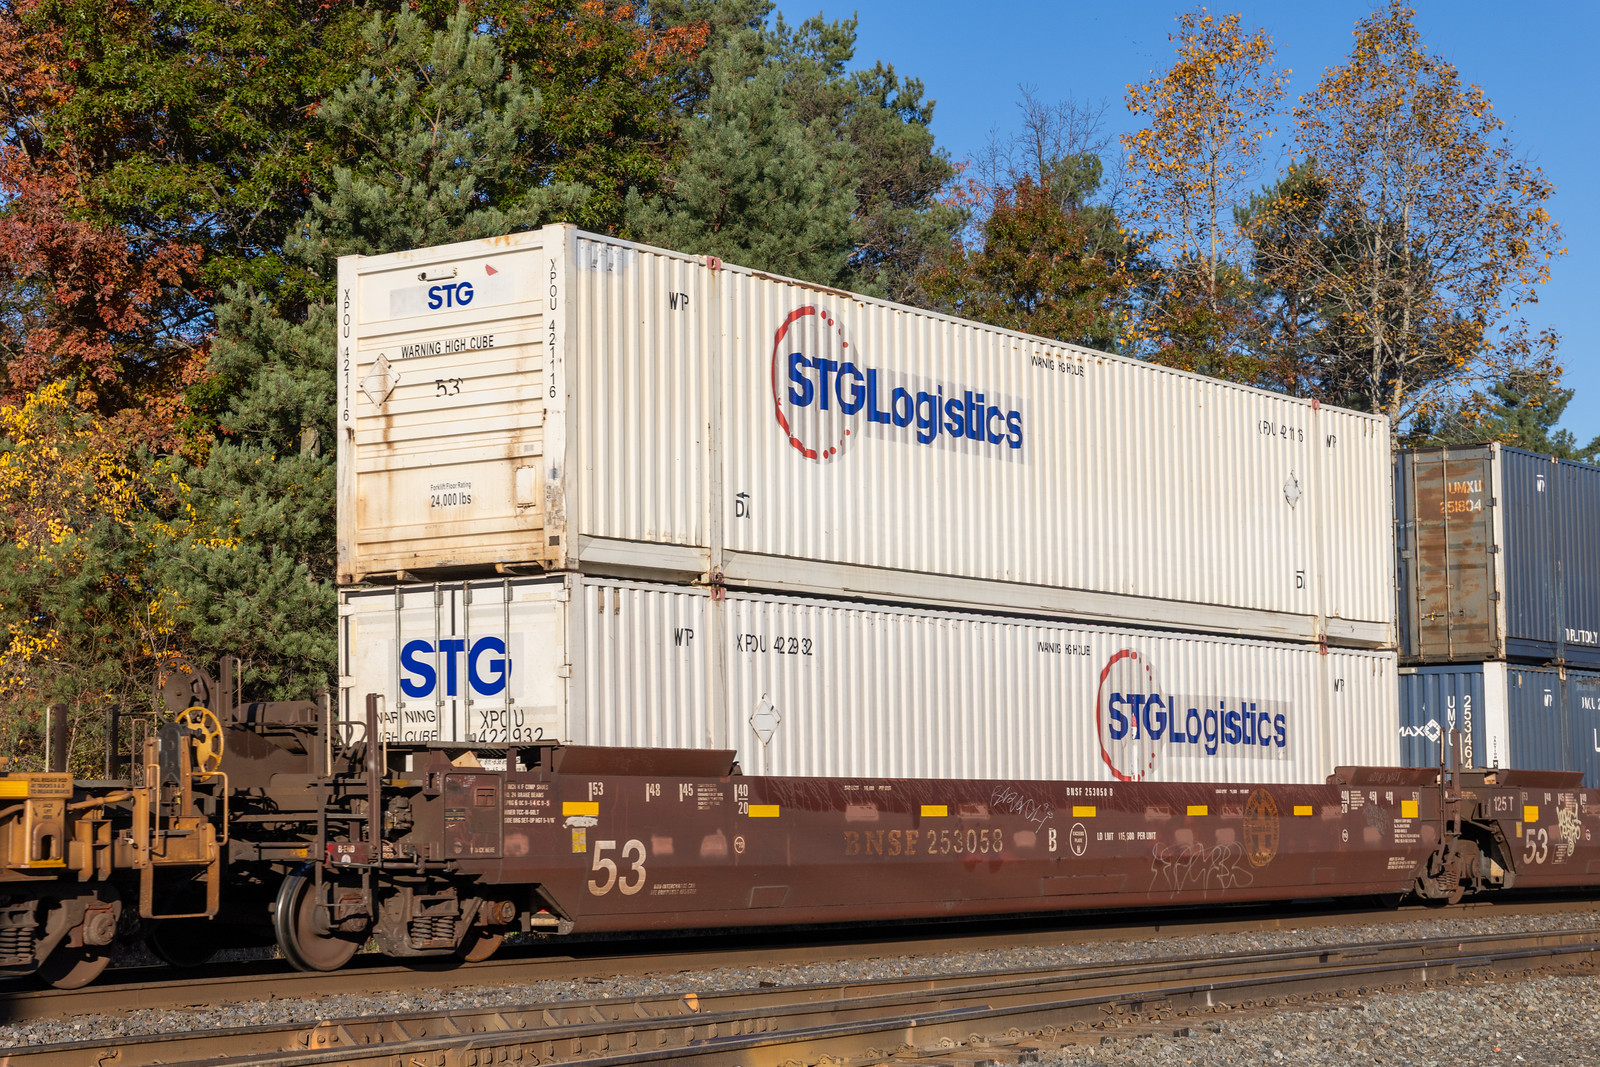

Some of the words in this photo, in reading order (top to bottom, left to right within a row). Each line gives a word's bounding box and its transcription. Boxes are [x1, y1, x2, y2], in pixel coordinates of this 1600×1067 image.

[428, 281, 474, 310] STG
[548, 258, 557, 311] XPOU
[343, 288, 351, 339] XPOU
[401, 341, 441, 359] WARNING
[445, 338, 466, 353] HIGH
[470, 334, 494, 350] CUBE
[548, 320, 556, 399] 421116
[1448, 479, 1482, 495] UMXU
[430, 493, 458, 509] 24,000
[459, 491, 472, 505] lbs
[1439, 498, 1482, 514] 251804
[674, 627, 694, 647] WP
[736, 633, 767, 653] XPOU
[773, 635, 813, 656] 422932
[400, 636, 512, 698] STG
[1463, 694, 1473, 770] 253464
[592, 782, 604, 796] 53
[649, 784, 661, 797] 48
[682, 783, 694, 797] 45
[738, 783, 749, 797] 40
[1066, 787, 1083, 797] BNSF
[1085, 787, 1108, 797] 253058
[738, 801, 749, 815] 20
[844, 829, 920, 856] BNSF
[926, 828, 1004, 855] 253058
[1048, 828, 1058, 853] B
[1523, 827, 1548, 865] 53
[587, 838, 647, 897] 53
